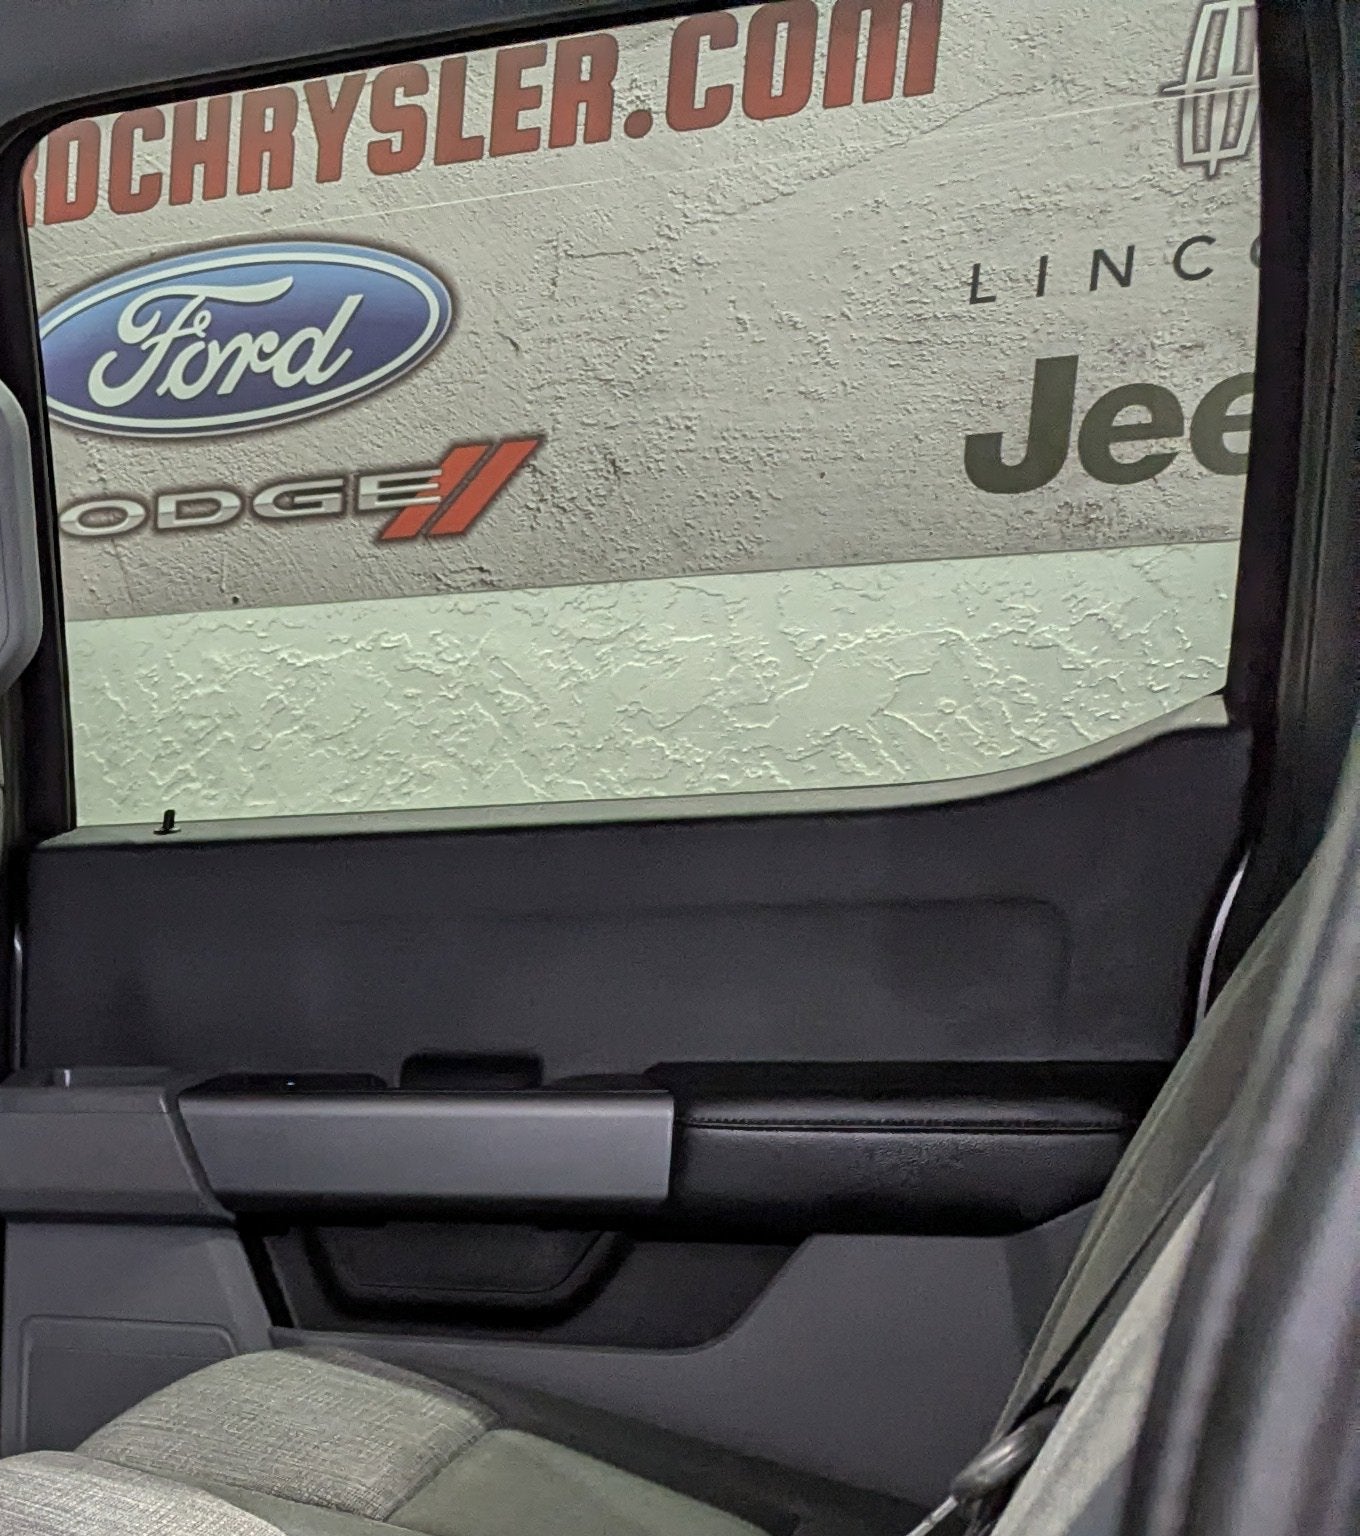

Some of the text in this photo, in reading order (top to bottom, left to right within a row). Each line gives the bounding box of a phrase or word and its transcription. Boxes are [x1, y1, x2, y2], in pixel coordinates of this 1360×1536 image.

[969, 235, 1261, 305] LINC
[88, 276, 364, 407] Ford
[964, 355, 1255, 494] Jee
[59, 469, 442, 537] ODGE
